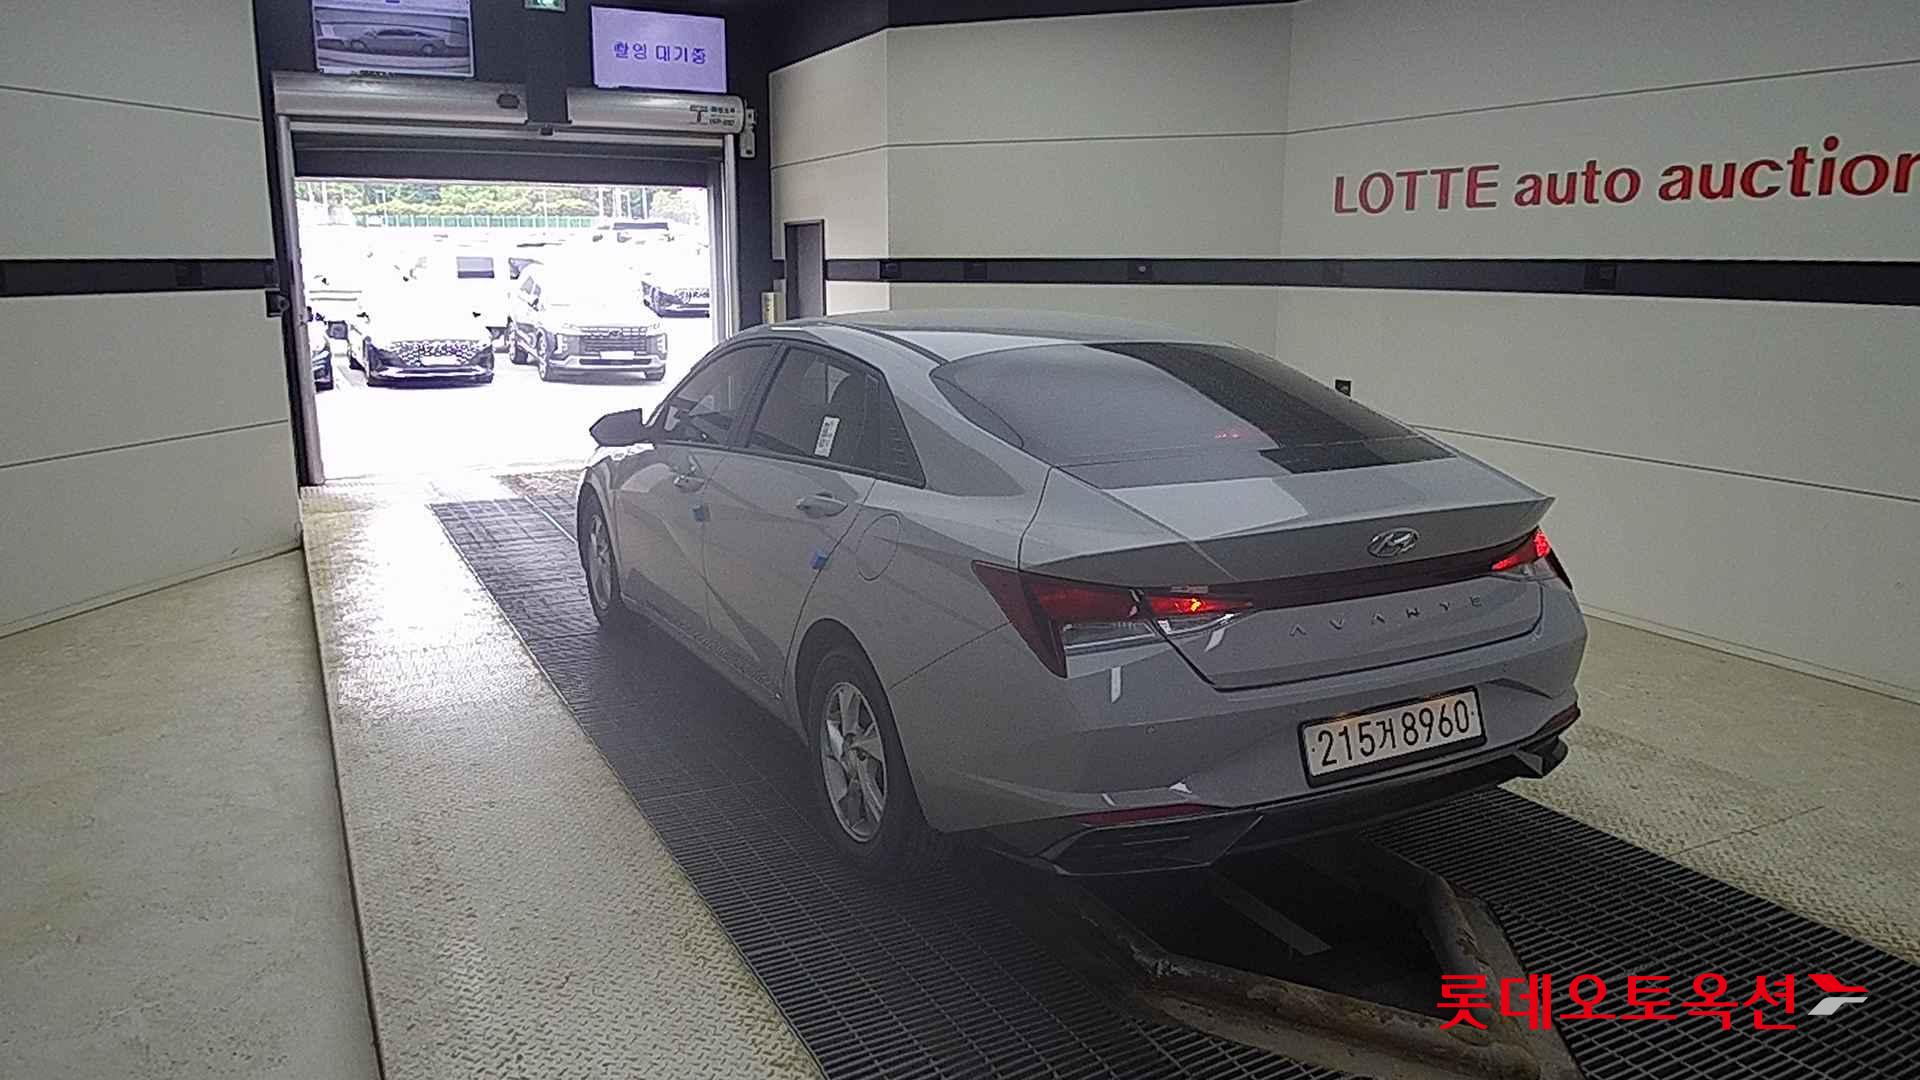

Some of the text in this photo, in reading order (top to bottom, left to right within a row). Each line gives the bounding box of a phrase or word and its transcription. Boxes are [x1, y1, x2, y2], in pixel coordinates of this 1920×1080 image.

[655, 45, 706, 65] 대기중
[1334, 164, 1500, 214] LOTTE
[1513, 159, 1641, 208] auto
[1317, 700, 1470, 767] 215거8960
